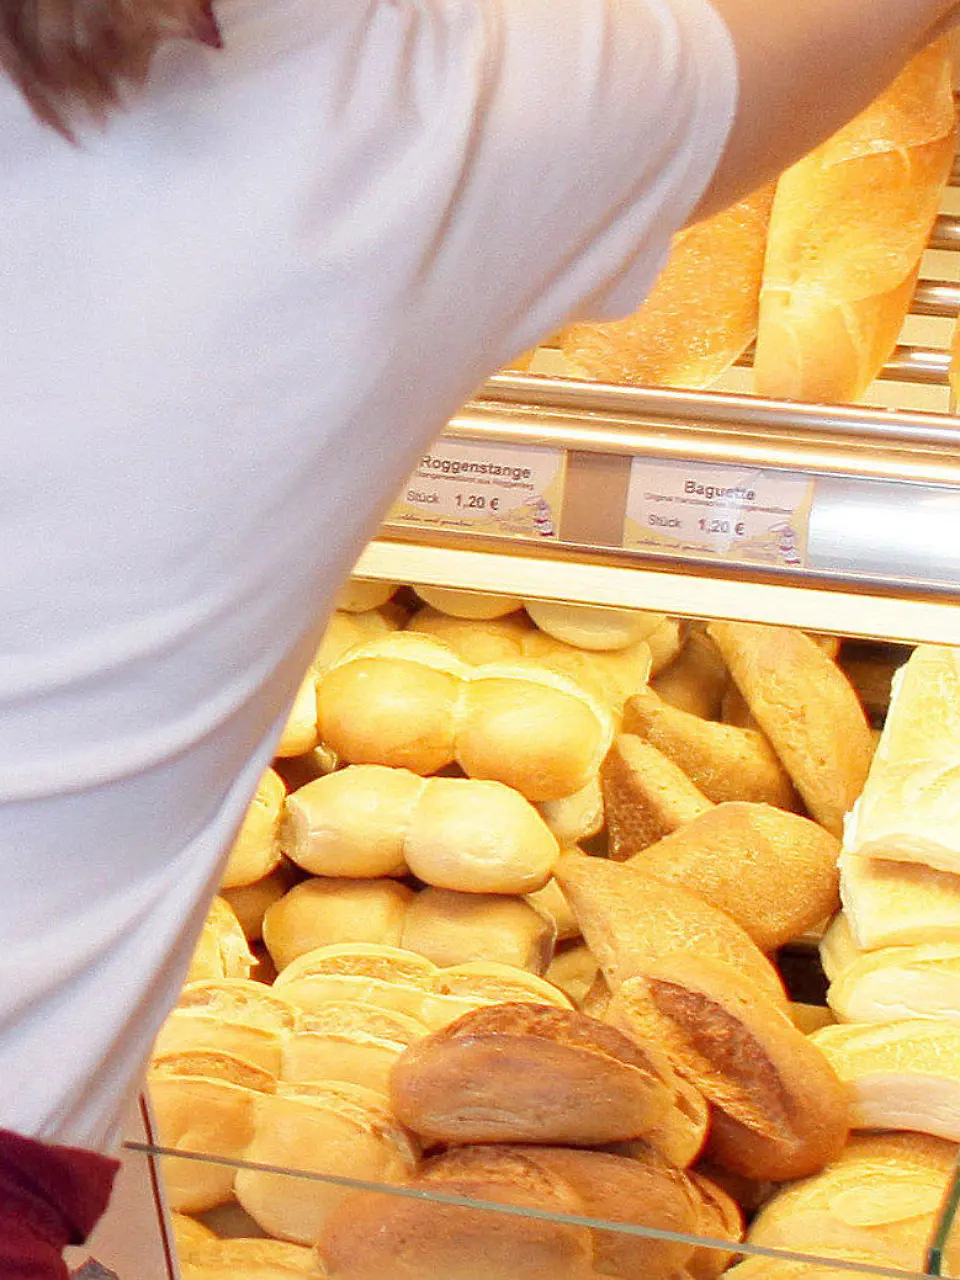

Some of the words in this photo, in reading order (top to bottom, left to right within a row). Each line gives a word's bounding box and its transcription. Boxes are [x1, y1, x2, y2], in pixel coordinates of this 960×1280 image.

[421, 455, 532, 480] Roggenstange
[406, 490, 440, 504] Stück
[455, 494, 486, 510] 1,20
[490, 498, 500, 510] €
[684, 480, 756, 501] Baguette
[647, 514, 681, 529] Stück
[698, 519, 730, 534] 1,20
[735, 522, 745, 536] €
